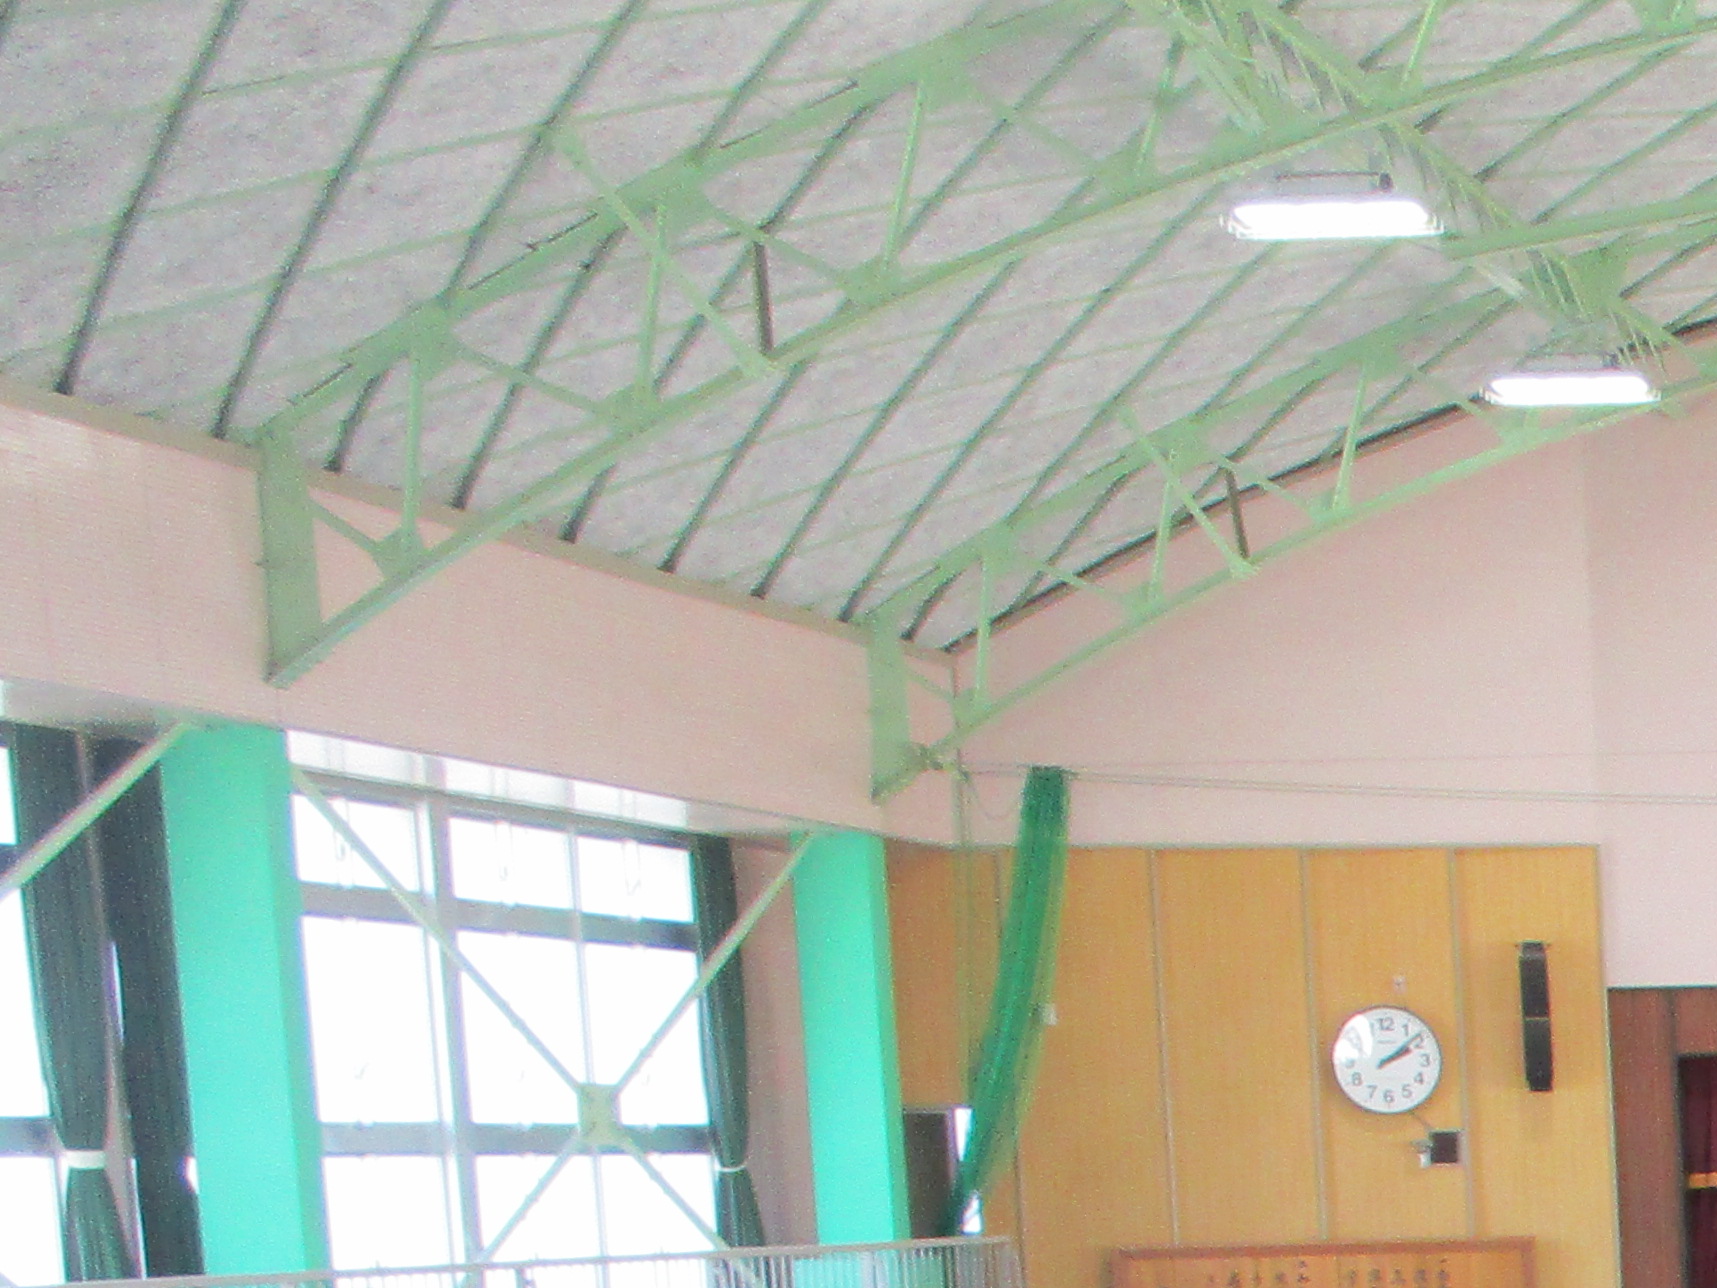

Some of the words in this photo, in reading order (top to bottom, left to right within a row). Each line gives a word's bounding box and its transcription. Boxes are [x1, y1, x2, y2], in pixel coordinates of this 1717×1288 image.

[1379, 1017, 1395, 1031] 12
[1402, 1023, 1410, 1037] 1
[1420, 1053, 1431, 1068] 3
[1351, 1072, 1363, 1086] 8
[1414, 1072, 1425, 1085] 4
[1367, 1085, 1378, 1099] 7
[1383, 1090, 1395, 1103] 6
[1402, 1083, 1413, 1098] 5
